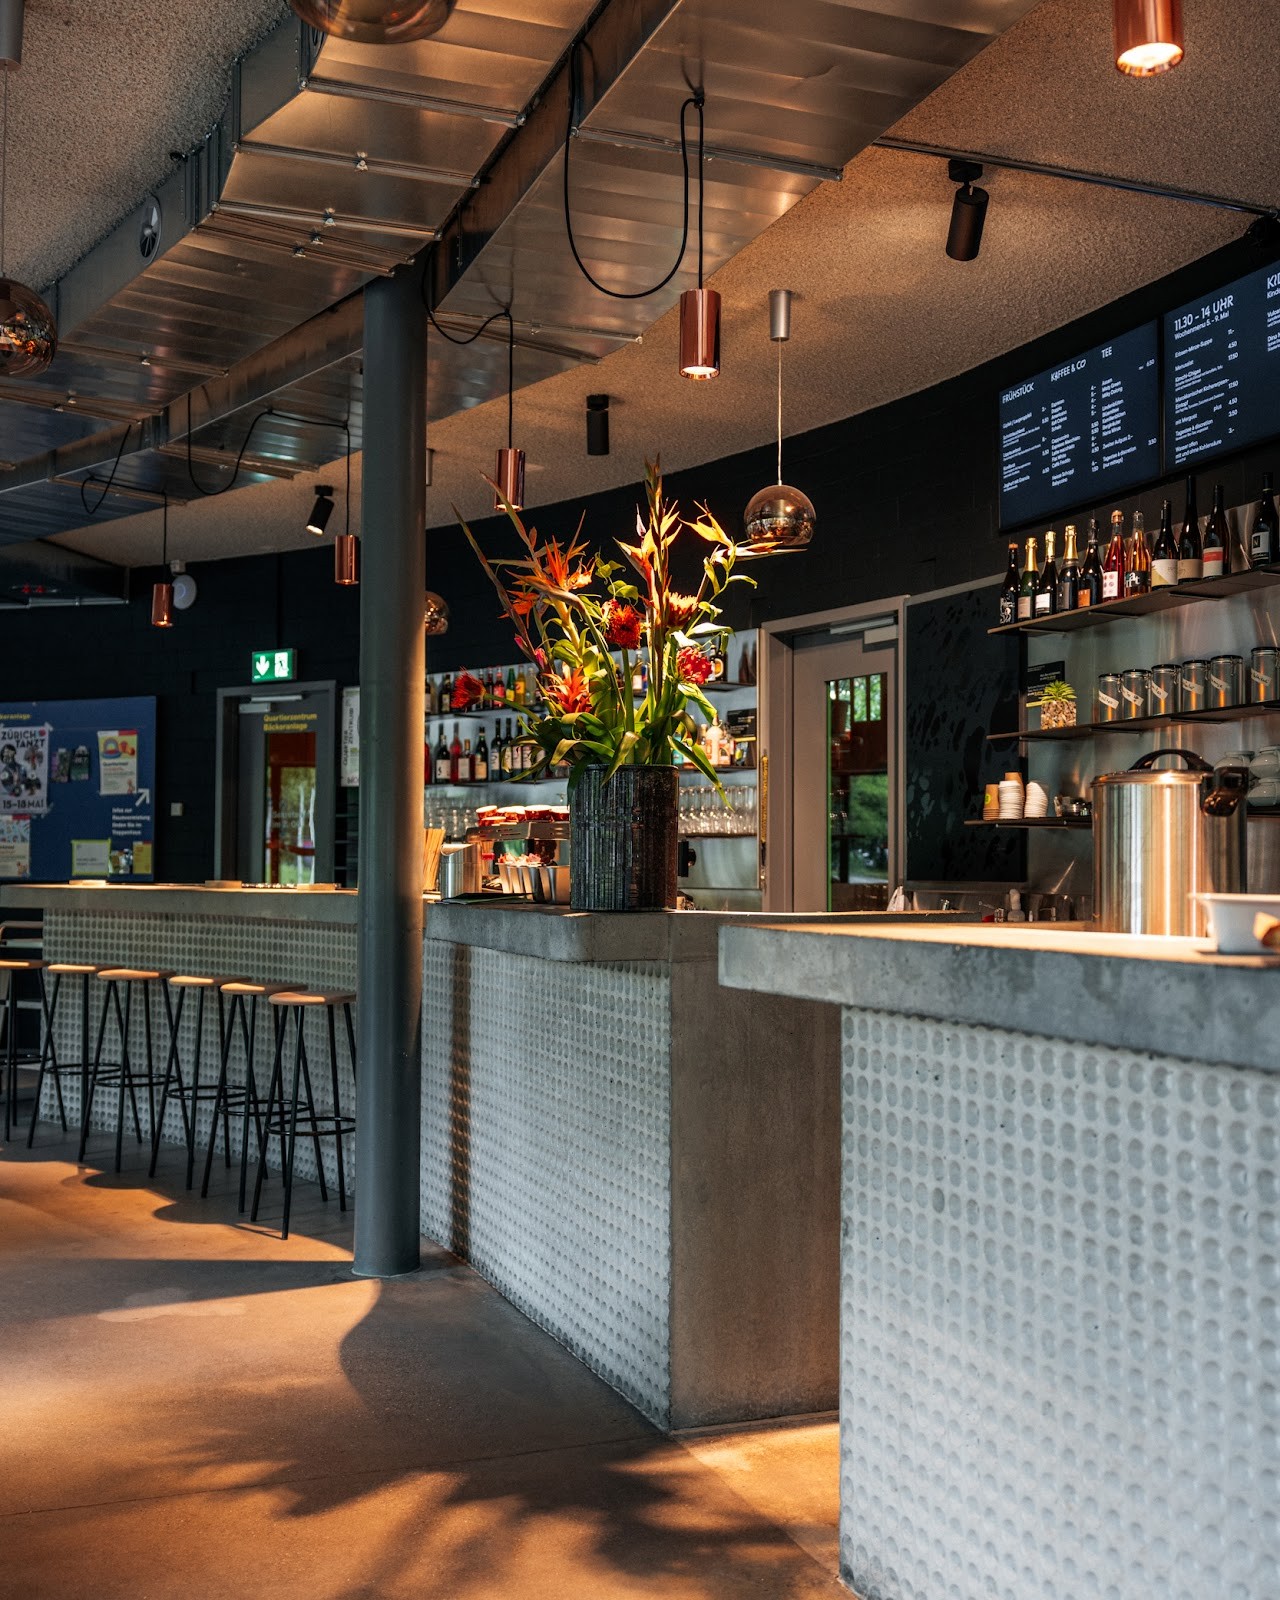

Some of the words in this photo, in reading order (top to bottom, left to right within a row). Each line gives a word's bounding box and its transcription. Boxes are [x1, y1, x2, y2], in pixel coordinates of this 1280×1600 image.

[1174, 313, 1193, 332] 11.30
[1201, 305, 1211, 319] 14
[1212, 295, 1234, 314] UHR
[1219, 310, 1230, 320] Mai
[1102, 346, 1113, 359] TEE
[1070, 363, 1076, 373] &
[1076, 359, 1087, 370] CO
[1002, 382, 1035, 404] FRÜHSTÜCK
[263, 713, 318, 722] Quartierzentrum
[2, 729, 36, 740] ZÜRICH
[16, 739, 46, 748] TANZT
[27, 799, 44, 809] MAI
